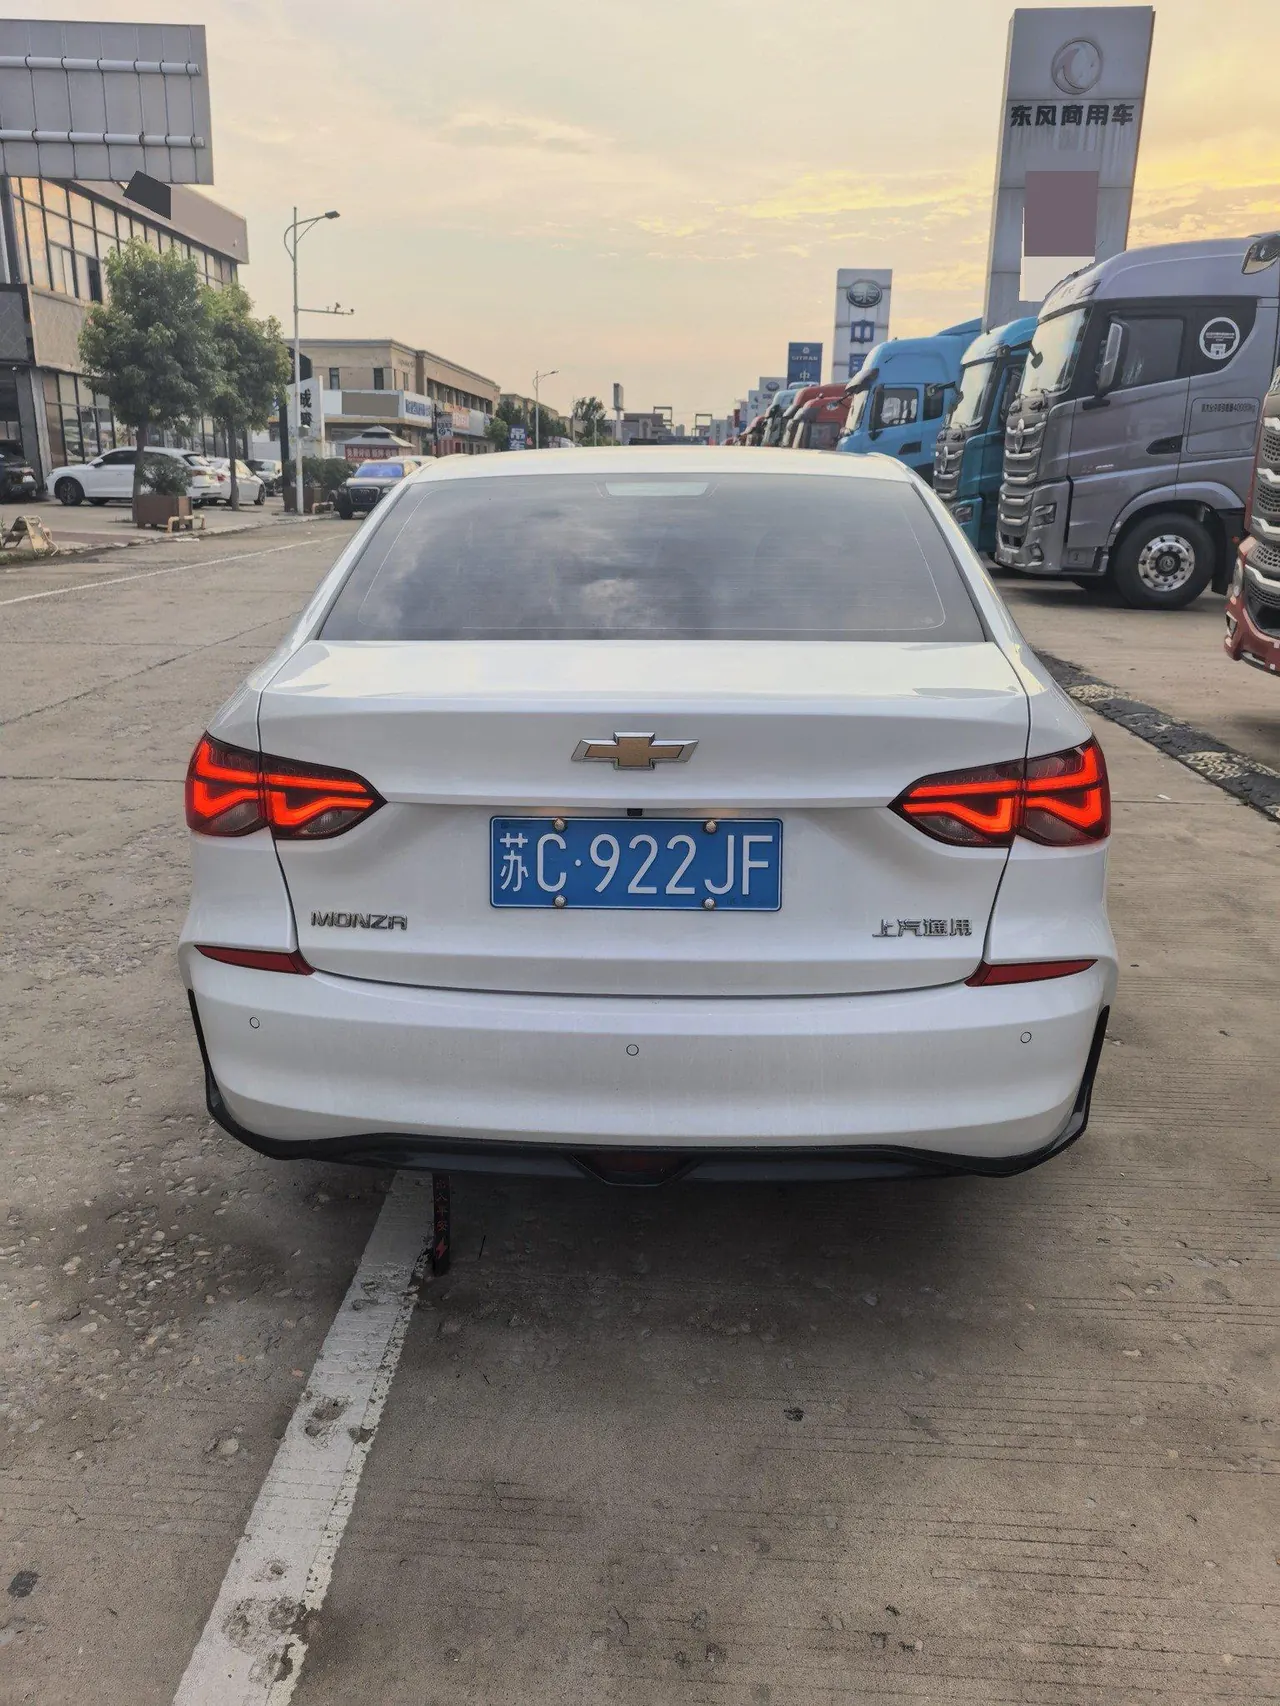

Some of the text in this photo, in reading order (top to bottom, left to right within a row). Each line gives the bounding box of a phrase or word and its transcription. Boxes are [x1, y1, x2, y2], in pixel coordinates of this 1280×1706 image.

[1011, 104, 1134, 127] 东风商用车
[500, 832, 773, 896] 苏C·922JF
[311, 911, 407, 930] MONZA
[872, 918, 972, 937] 上汽通用
